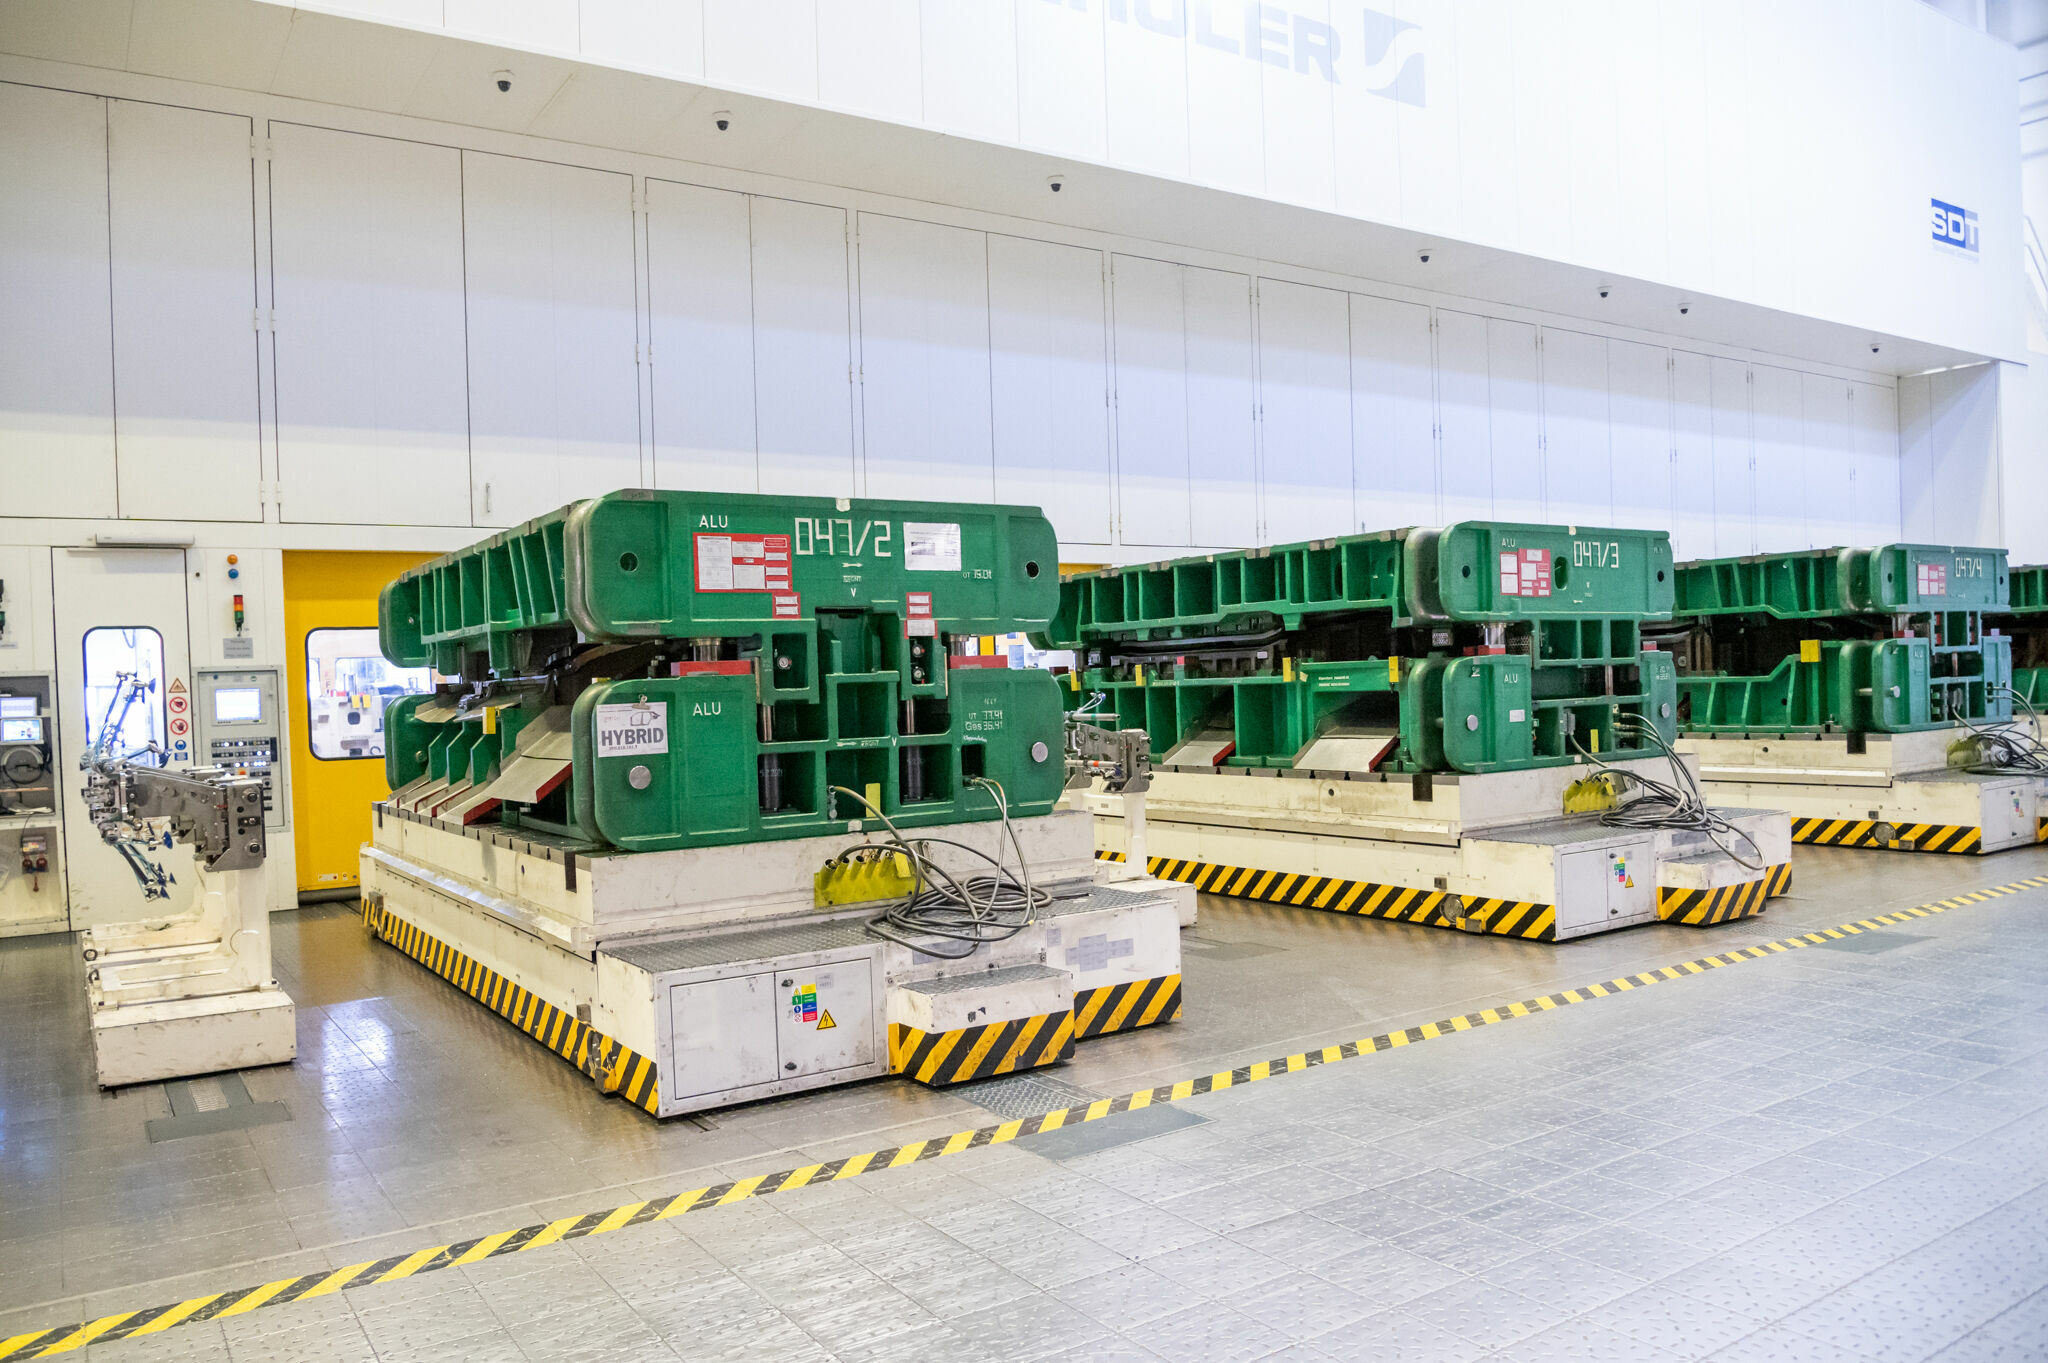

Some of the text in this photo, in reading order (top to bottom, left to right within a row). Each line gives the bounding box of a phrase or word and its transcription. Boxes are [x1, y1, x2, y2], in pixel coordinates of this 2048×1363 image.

[699, 514, 729, 529] ALU
[795, 517, 892, 557] 047/2
[1573, 540, 1619, 569] 047/3
[1504, 673, 1519, 684] ALU
[692, 701, 722, 717] ALU
[601, 728, 664, 746] HYBRID
